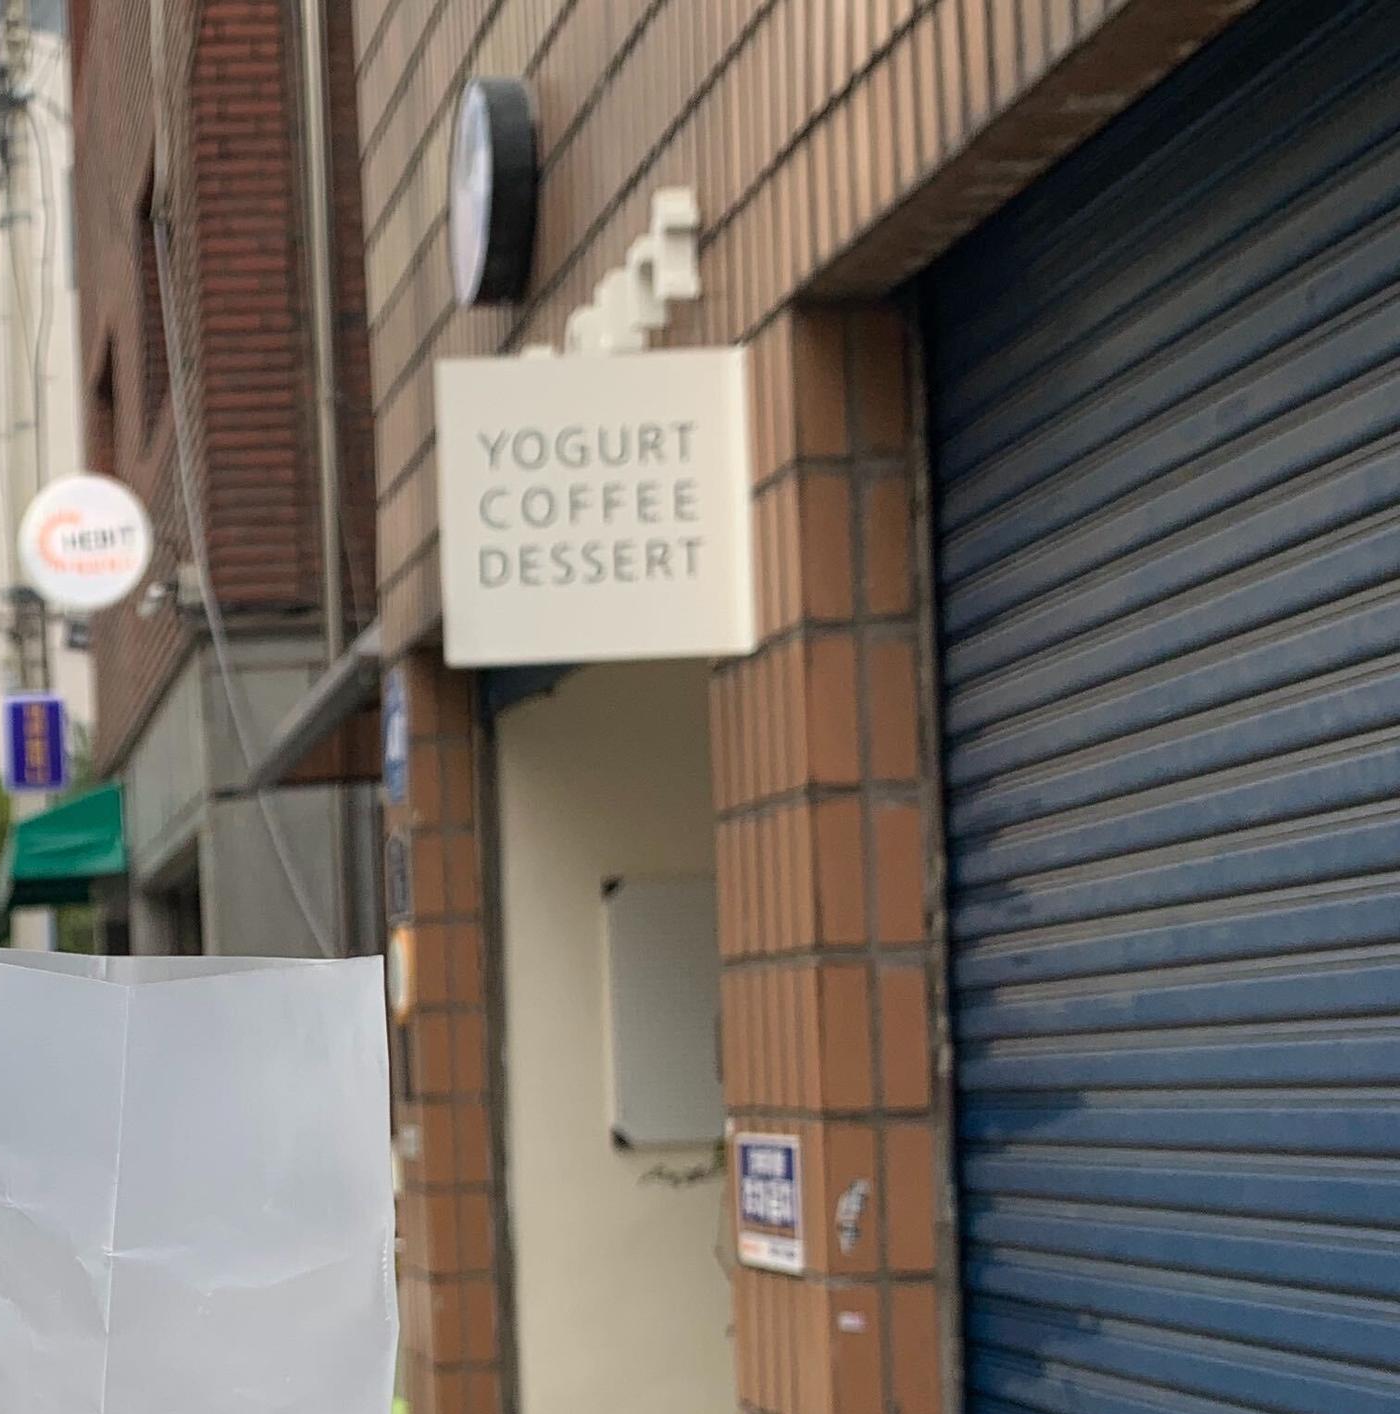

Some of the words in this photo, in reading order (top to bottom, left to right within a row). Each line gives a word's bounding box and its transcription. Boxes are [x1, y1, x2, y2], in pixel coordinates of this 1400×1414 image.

[477, 420, 698, 470] YOGURT
[478, 478, 701, 530] COFFEE
[478, 535, 705, 589] DESSERT
